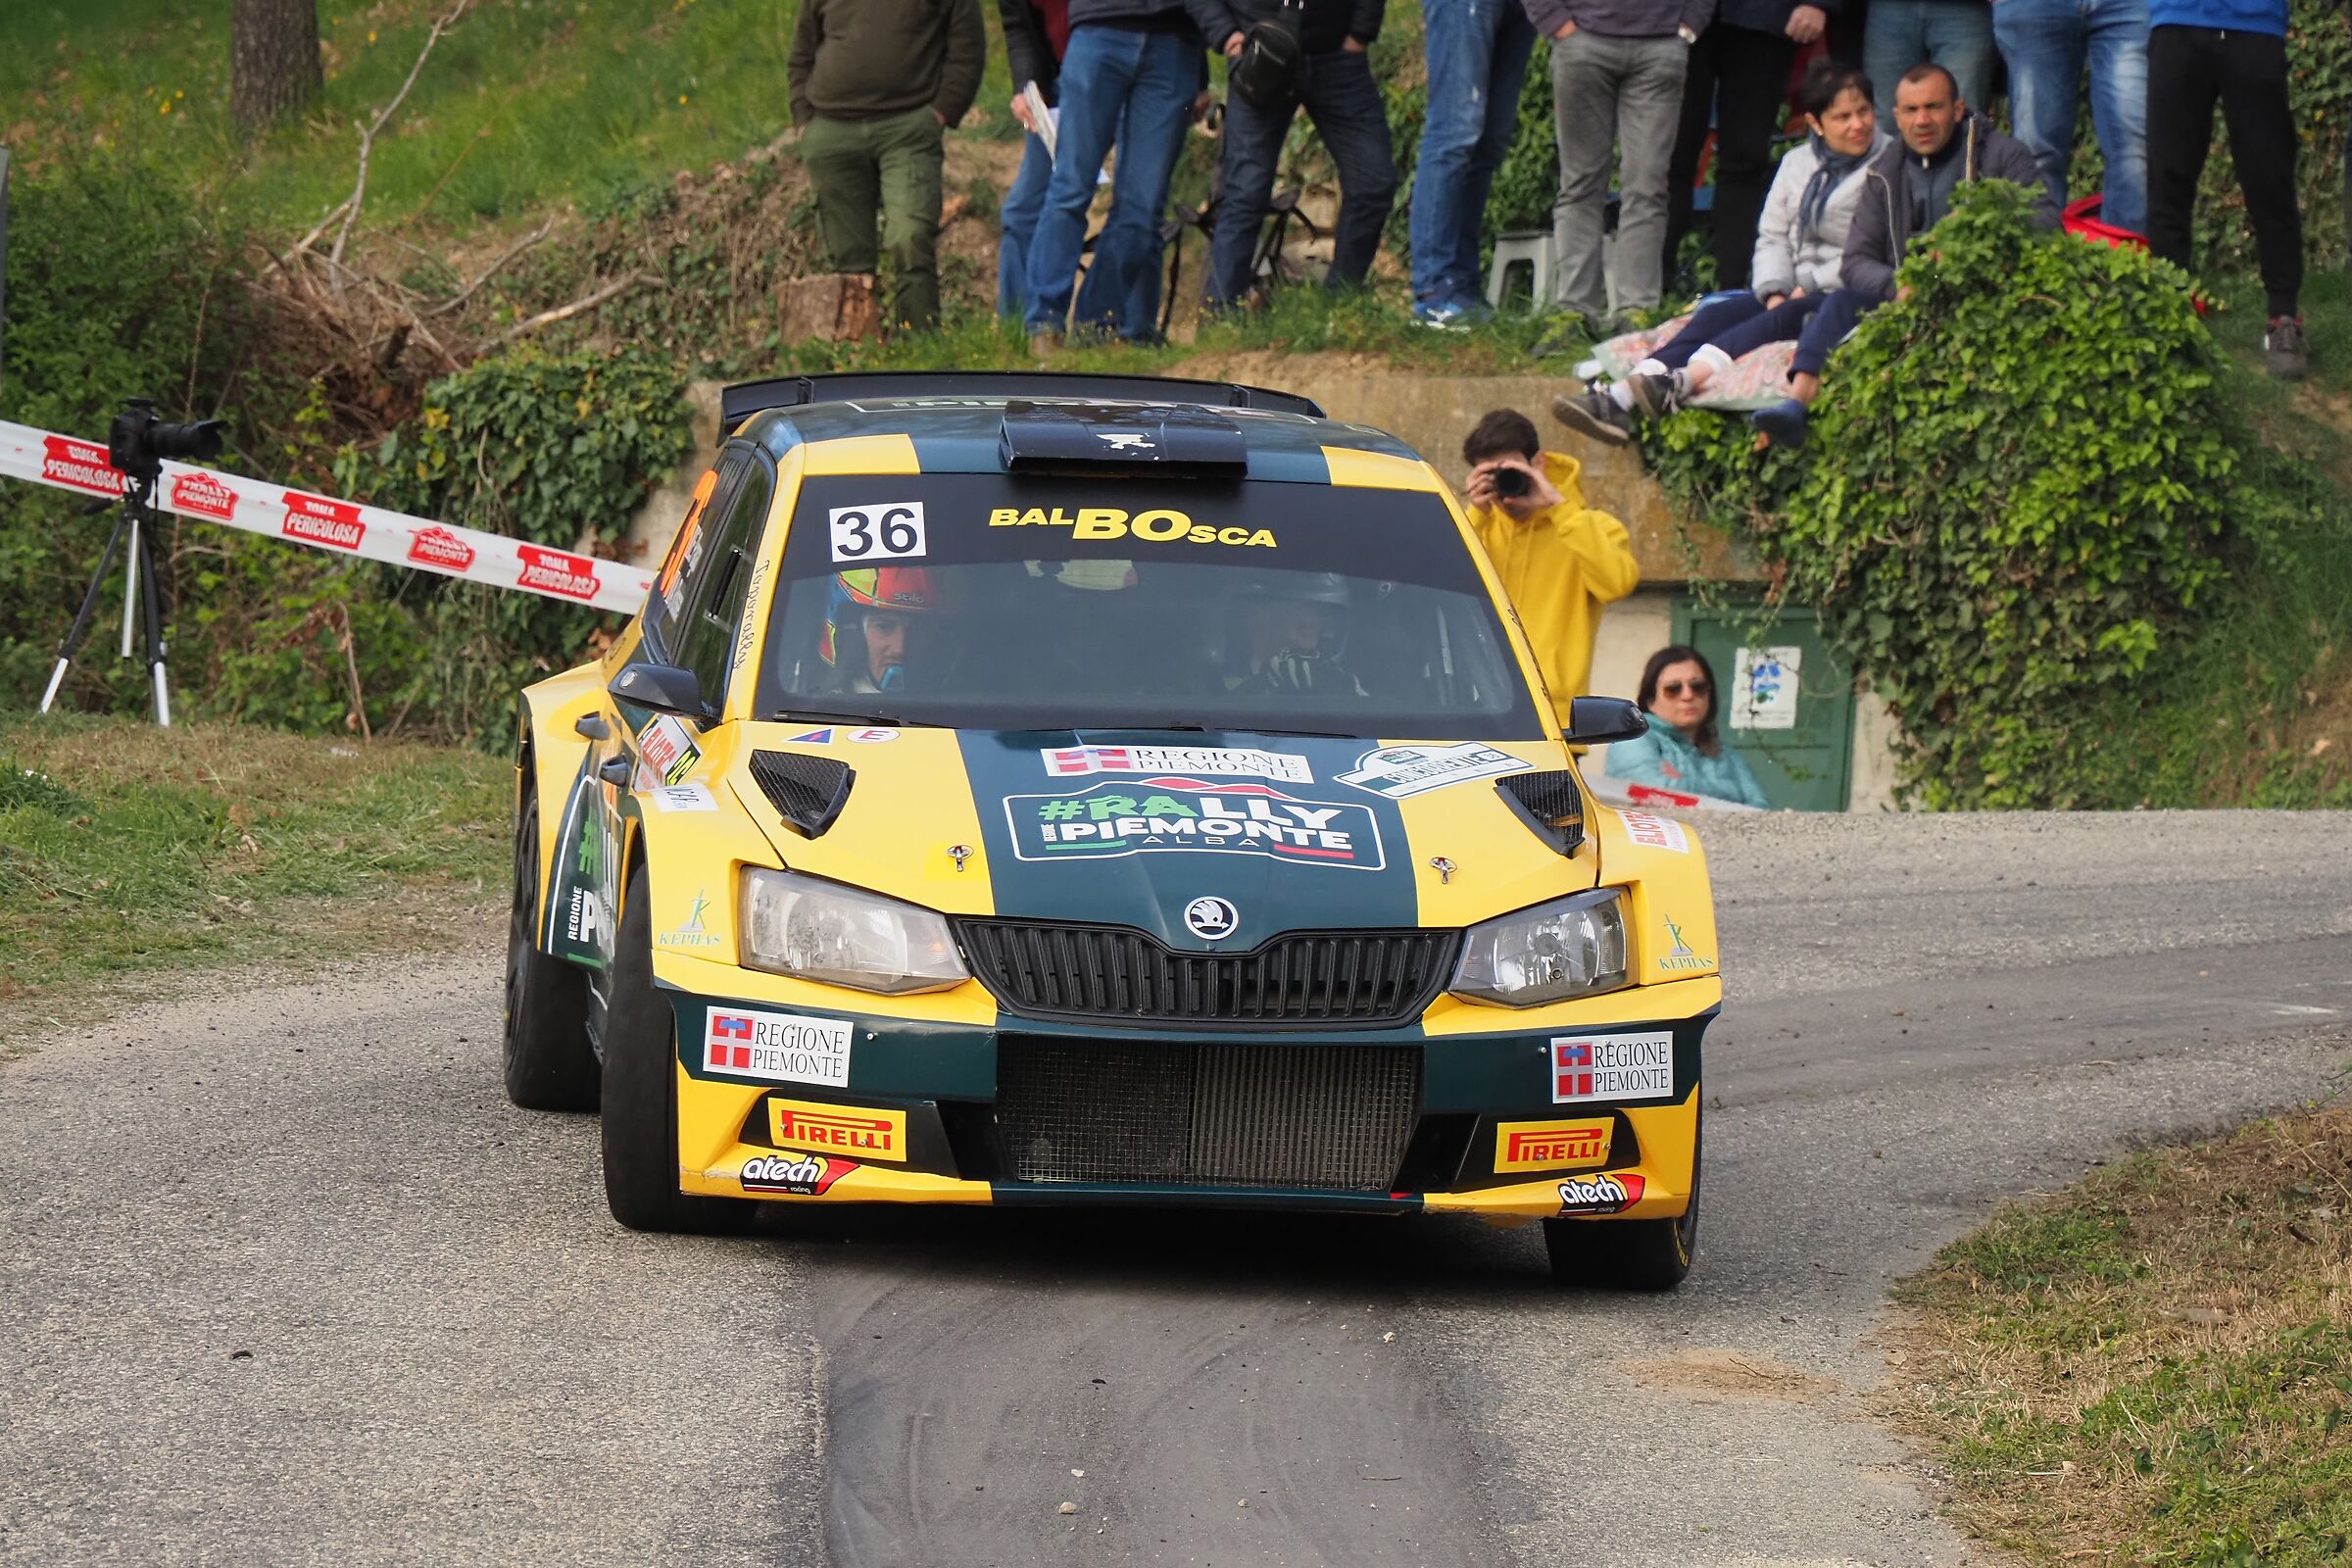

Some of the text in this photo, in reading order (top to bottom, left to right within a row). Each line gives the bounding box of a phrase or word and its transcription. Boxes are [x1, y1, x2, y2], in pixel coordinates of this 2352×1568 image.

[47, 460, 121, 490] PERICOLOSA
[286, 513, 361, 545] PERICOLOSA
[837, 508, 917, 557] 36
[989, 508, 1277, 548] BALBOSCA
[522, 565, 596, 595] PERICOLOSA
[858, 730, 889, 740] E
[1135, 750, 1298, 769] REGIONE
[1139, 760, 1302, 780] PIEMONTE
[1039, 795, 1343, 829] #RALLY
[1060, 817, 1353, 850] PIEMONTE
[1143, 836, 1260, 848] ALBA
[567, 885, 583, 941] REGIONE
[659, 933, 721, 945] KEPHAS
[1659, 956, 1713, 969] KEPHAS
[755, 1022, 845, 1054] REGIONE
[753, 1049, 843, 1078] PIEMONTE
[1594, 1042, 1668, 1068] REGIONE
[1594, 1068, 1668, 1093] PIEMONTE
[781, 1110, 893, 1151] PIRELLI
[1506, 1128, 1602, 1162] PIRELLI
[742, 1154, 819, 1183] atech
[1559, 1175, 1624, 1204] atech
